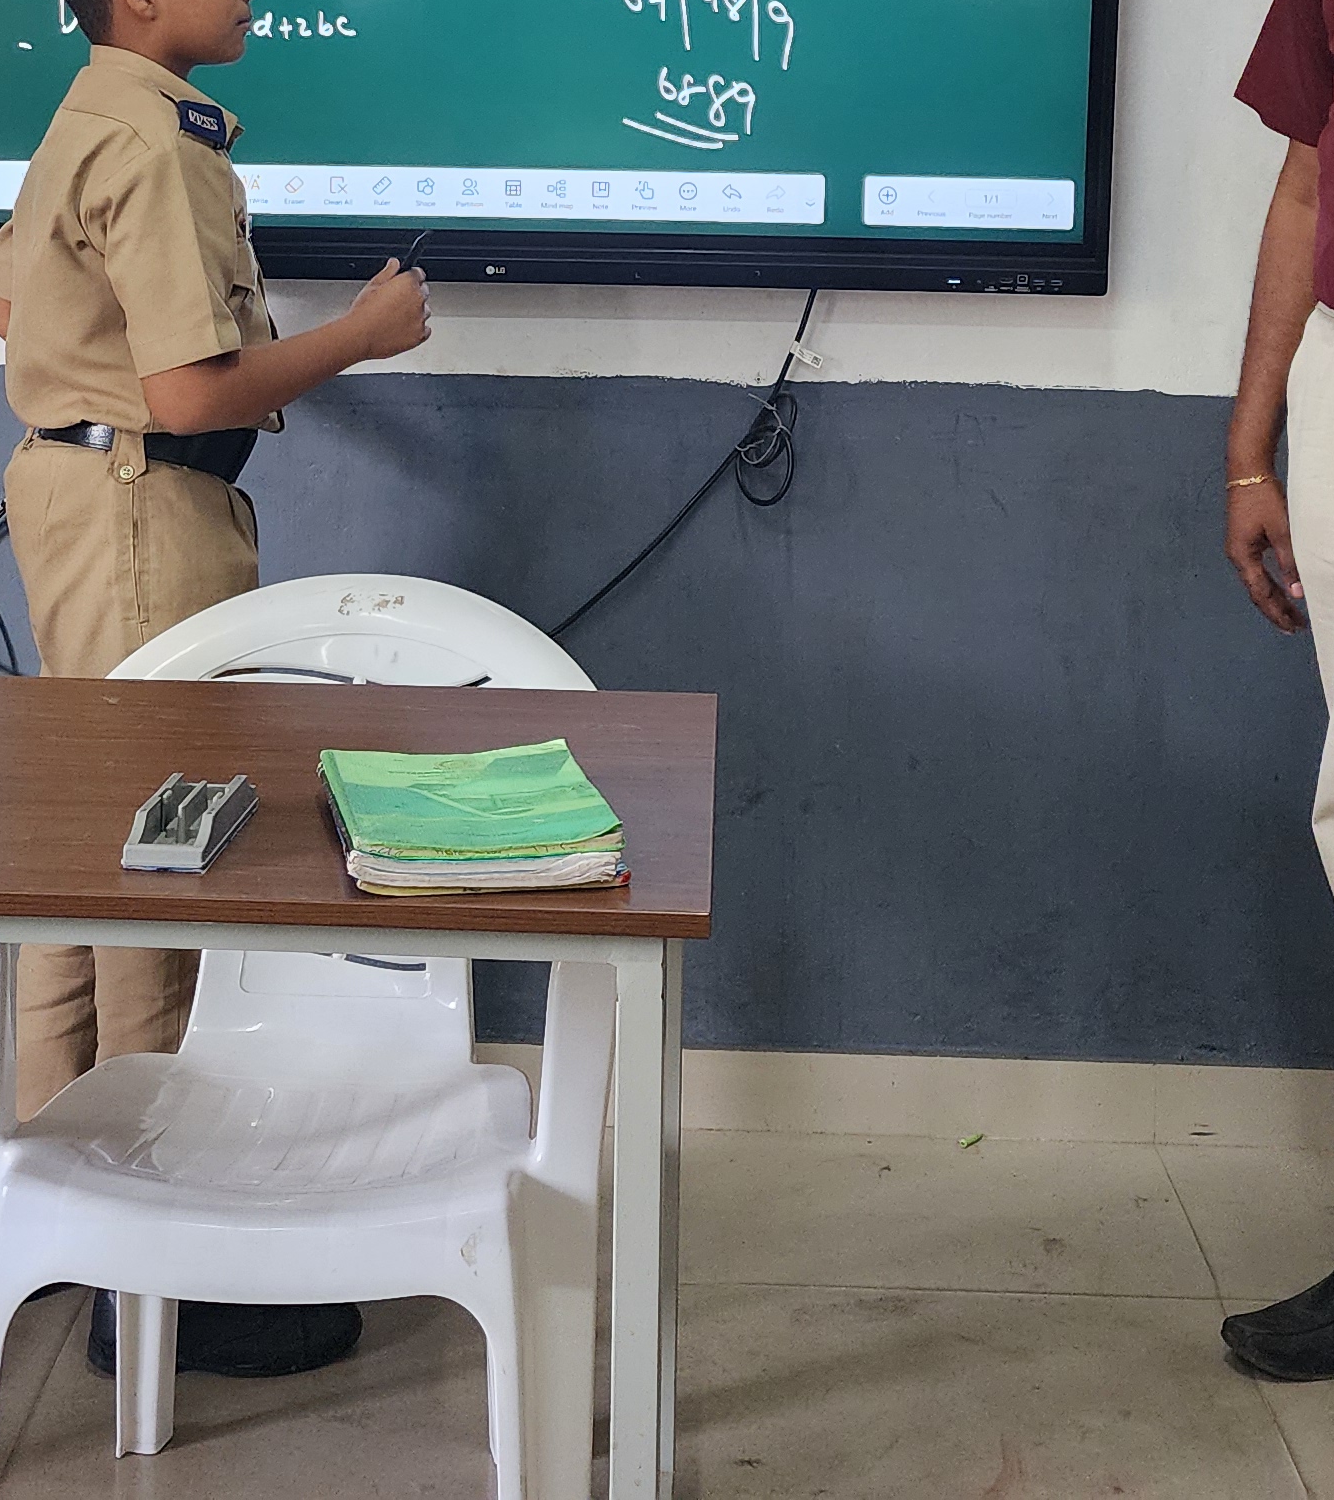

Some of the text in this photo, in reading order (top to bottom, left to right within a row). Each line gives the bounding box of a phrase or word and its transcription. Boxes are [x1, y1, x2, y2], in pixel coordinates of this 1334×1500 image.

[657, 66, 757, 135] 6889
[983, 194, 999, 204] 1/1
[415, 200, 436, 208] Shape
[504, 201, 523, 209] Table
[592, 203, 609, 211] Note
[723, 205, 741, 213] Undo
